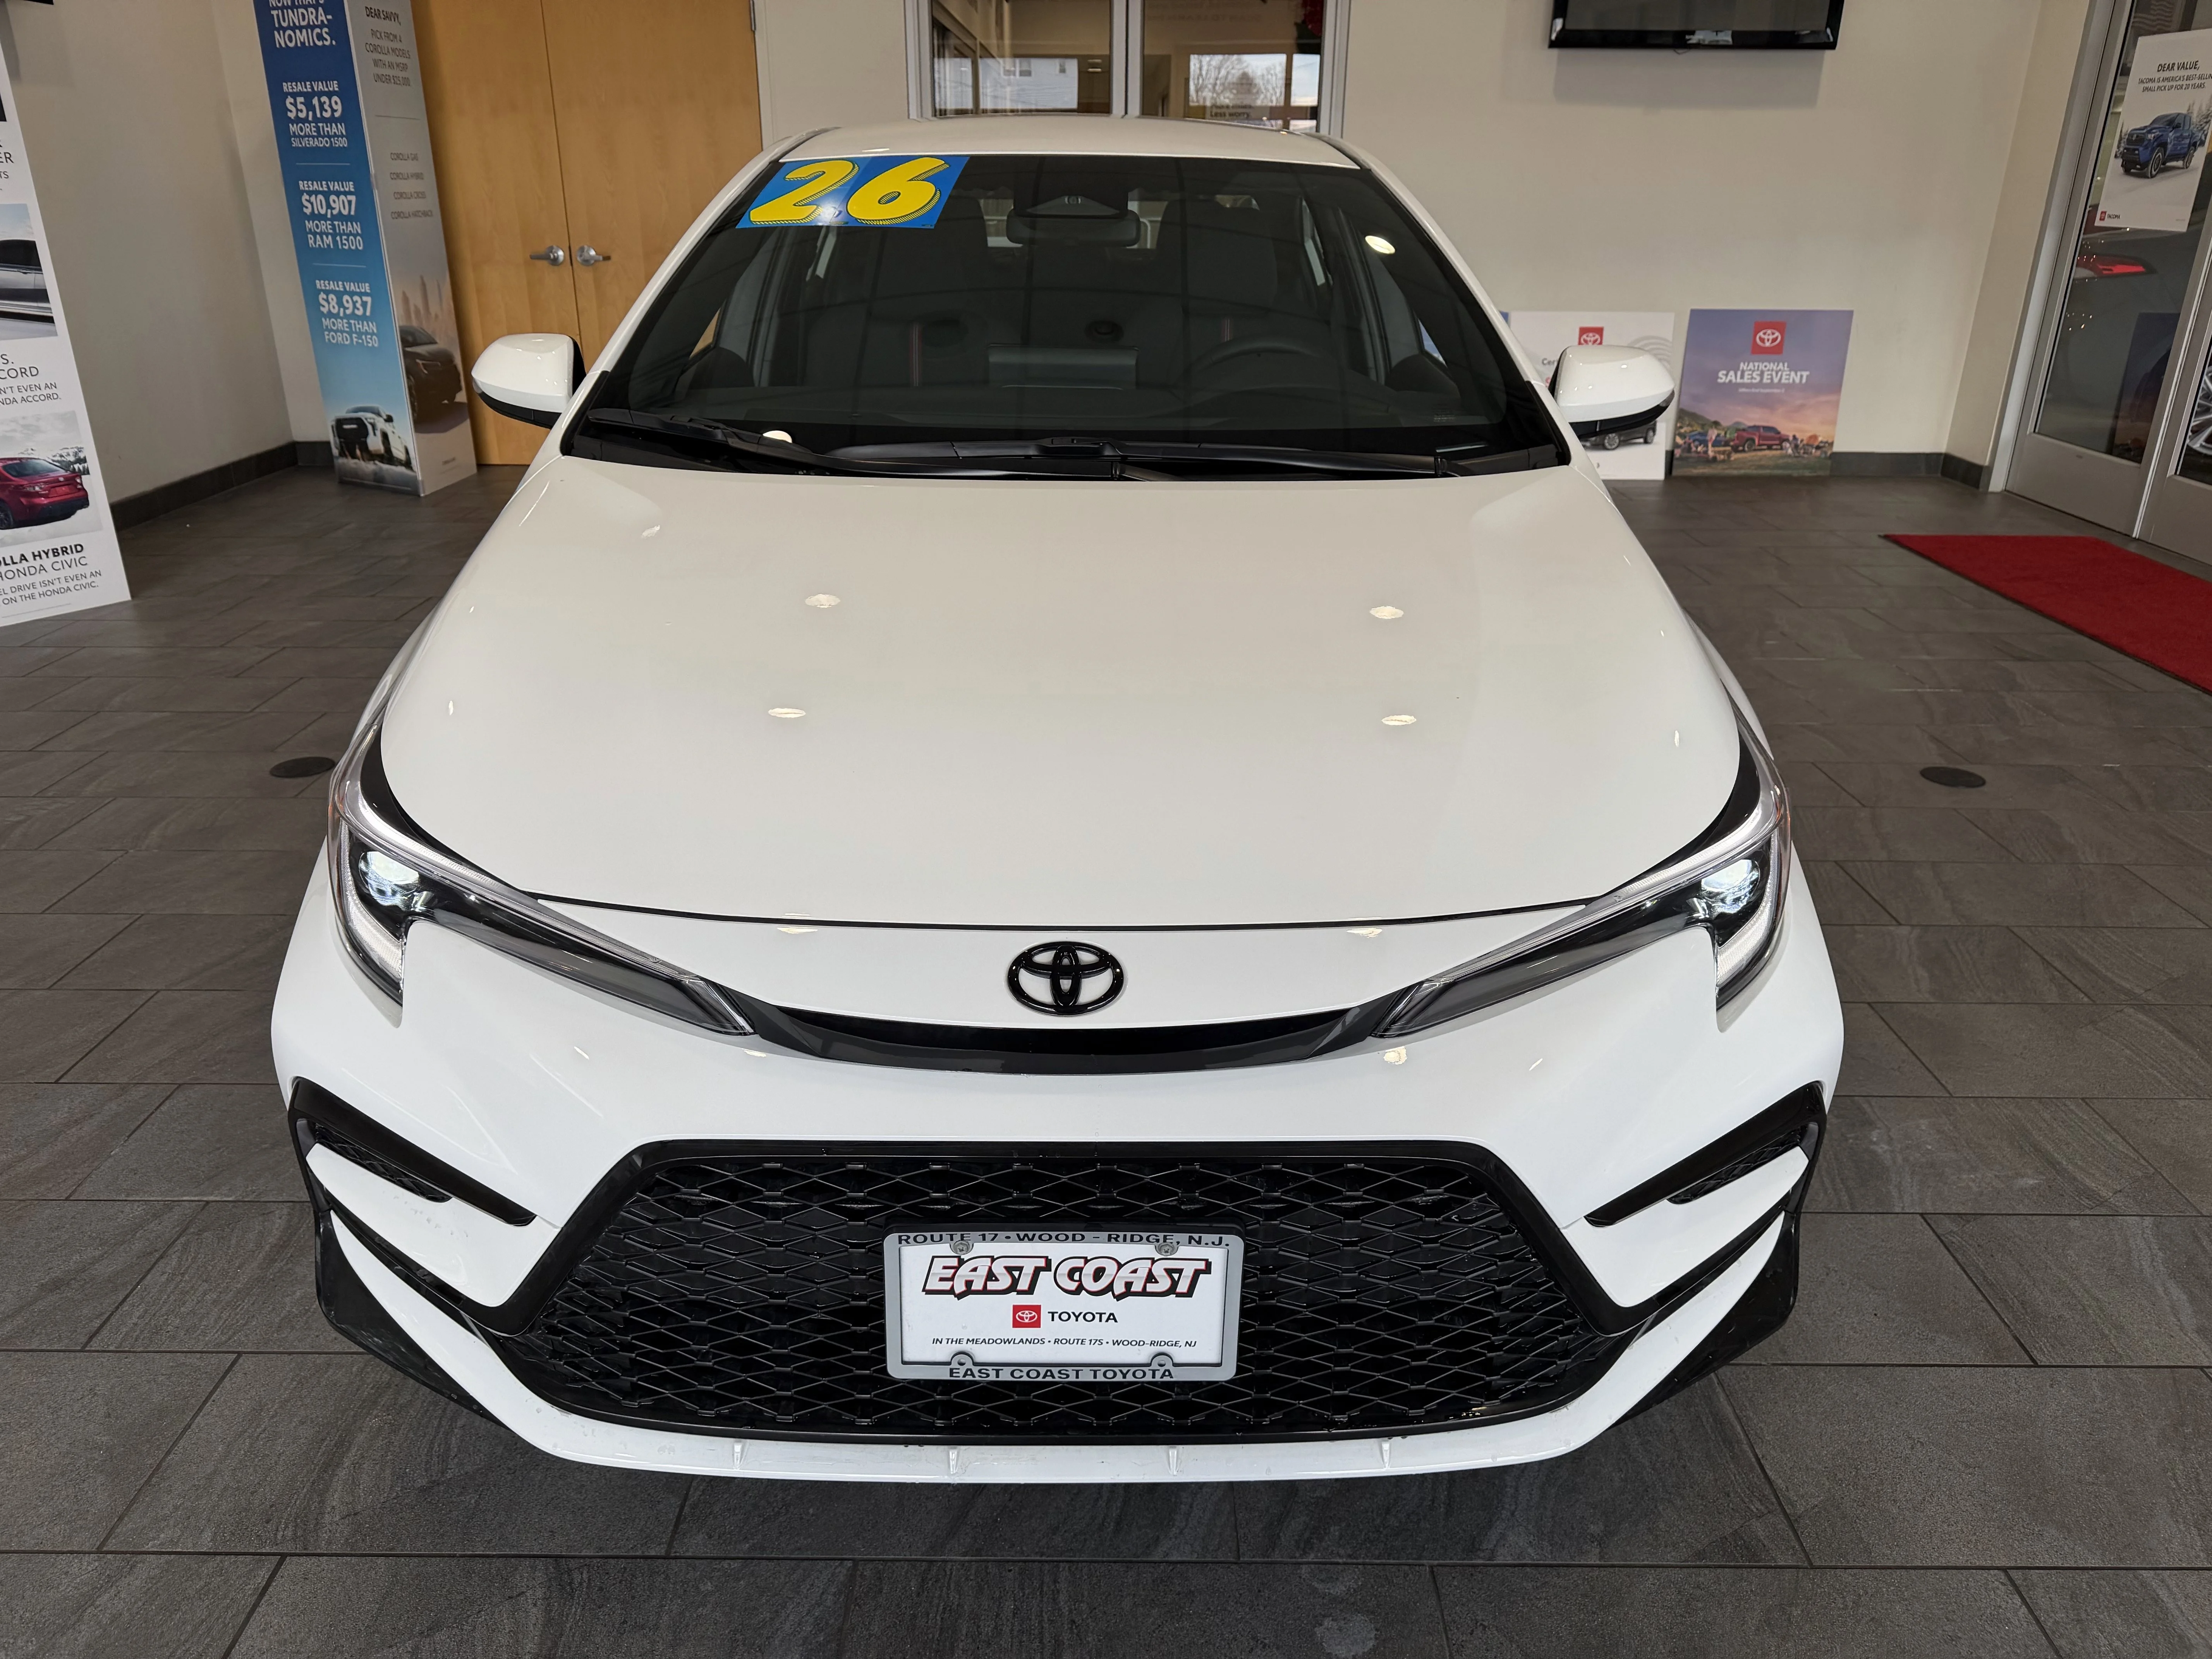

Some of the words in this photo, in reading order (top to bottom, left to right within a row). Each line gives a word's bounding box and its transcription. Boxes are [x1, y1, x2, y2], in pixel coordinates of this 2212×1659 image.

[271, 7, 333, 27] TUNDRA-
[365, 6, 382, 19] DEAR
[382, 10, 401, 26] SAVVY,
[274, 27, 336, 48] NOMICS.
[371, 29, 383, 40] PICK
[383, 31, 397, 43] FROM
[365, 42, 390, 55] COROLLA
[390, 47, 411, 59] MODELS
[372, 58, 386, 69] WITH
[387, 60, 395, 70] AN
[2157, 62, 2176, 72] DEAR
[2177, 60, 2200, 71] VALUE,
[373, 72, 392, 84] UNDER
[2161, 75, 2185, 83] AMERICA'S
[283, 82, 312, 93] RESALE
[312, 81, 339, 92] VALUE
[285, 95, 342, 121] $5,139
[289, 123, 318, 136] MORE
[318, 122, 346, 135] THAN
[291, 137, 330, 147] SILVERADO
[331, 137, 348, 147] 1500
[299, 180, 328, 191] RESALE
[328, 181, 355, 191] VALUE
[748, 156, 950, 225] 26
[301, 192, 356, 218] $10,907
[305, 220, 333, 233] MORE
[333, 221, 362, 234] THAN
[307, 234, 333, 249] RAM
[336, 235, 363, 250] 1500
[315, 280, 344, 291] RESALE
[344, 282, 371, 293] VALUE
[318, 292, 371, 317] $8,937
[322, 317, 350, 331] MORE
[349, 320, 377, 333] THAN
[324, 331, 350, 345] FORD
[352, 333, 379, 347] F-150
[1542, 357, 1557, 366] Cer
[1739, 362, 1790, 371] NATIONAL
[1717, 370, 1761, 383] SALES
[1763, 371, 1810, 384] EVENT
[17, 383, 41, 393] EVEN
[44, 382, 57, 390] AN
[21, 392, 62, 404] ACCORD.
[0, 553, 29, 567] LLA
[31, 543, 84, 561] HYBRID
[51, 556, 88, 571] CIVIC
[10, 582, 37, 594] DRIVE
[39, 577, 62, 587] ISN'T
[64, 572, 87, 583] EVEN
[89, 569, 102, 578] AN
[2, 596, 17, 605] ON
[19, 592, 37, 601] THE
[38, 586, 72, 598] HONDA
[73, 581, 99, 591] CIVIC.
[898, 1233, 971, 1245] ROUTE
[978, 1233, 999, 1242] 17
[1016, 1233, 1085, 1242] WOOD
[1107, 1233, 1181, 1245] RIDGE,
[1188, 1235, 1230, 1247] N.J.
[922, 1255, 1052, 1301] EAST
[1053, 1255, 1212, 1302] COAST
[1048, 1311, 1118, 1323] TOYOTA
[1112, 1339, 1182, 1348] WOOD-RIDGE,
[949, 1367, 1004, 1379] EAST
[1010, 1368, 1084, 1379] COAST
[1089, 1368, 1174, 1379] TOYOTA
